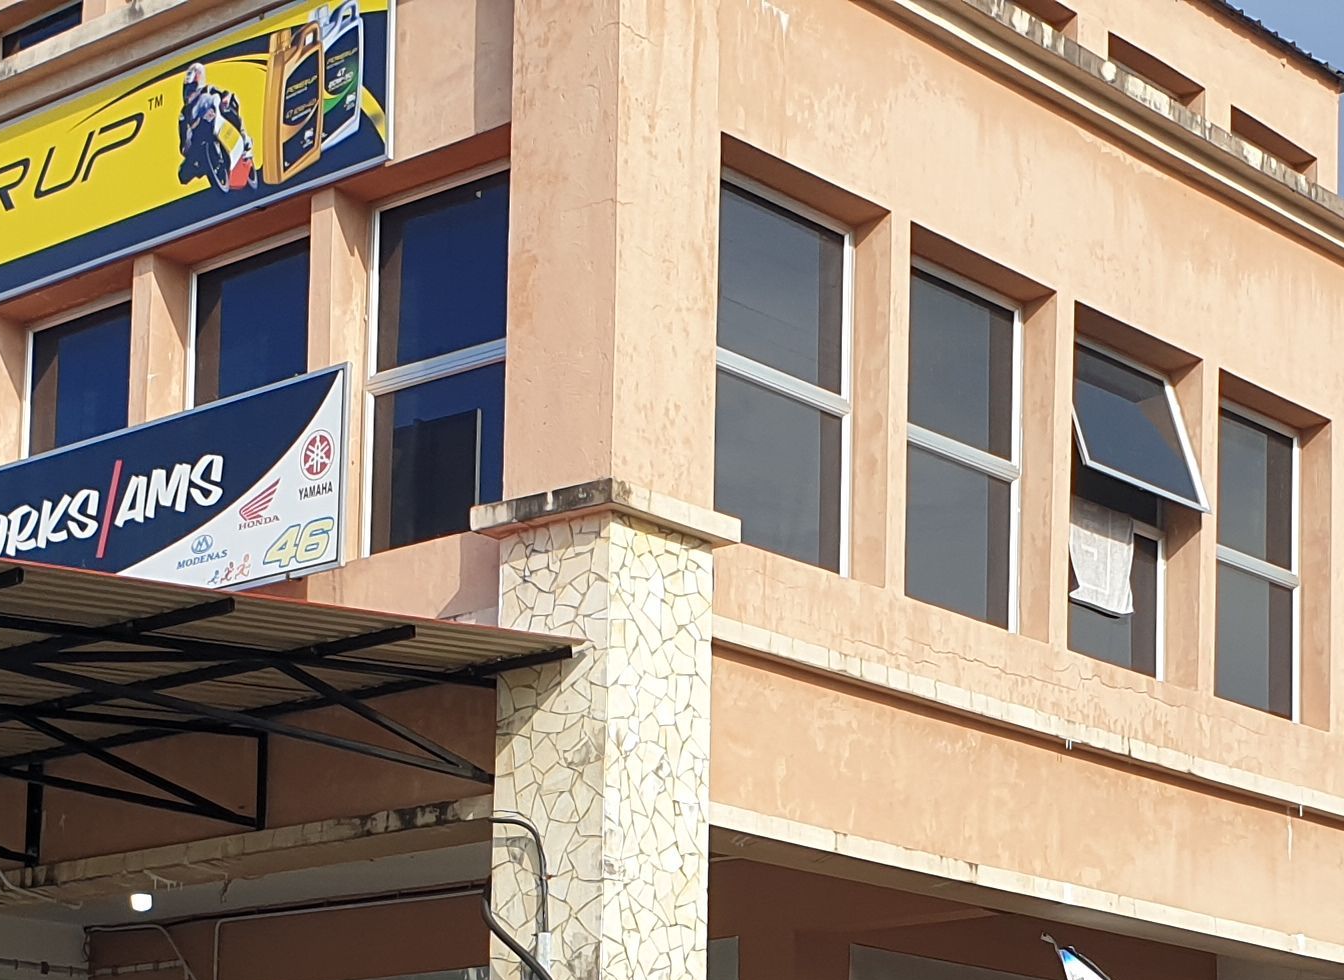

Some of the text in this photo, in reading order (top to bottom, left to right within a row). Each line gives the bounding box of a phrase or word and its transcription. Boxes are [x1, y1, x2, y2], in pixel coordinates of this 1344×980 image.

[298, 481, 334, 501] YAMAHA
[238, 514, 280, 531] HONDA
[262, 516, 335, 569] 46
[176, 549, 228, 570] MODENAS
